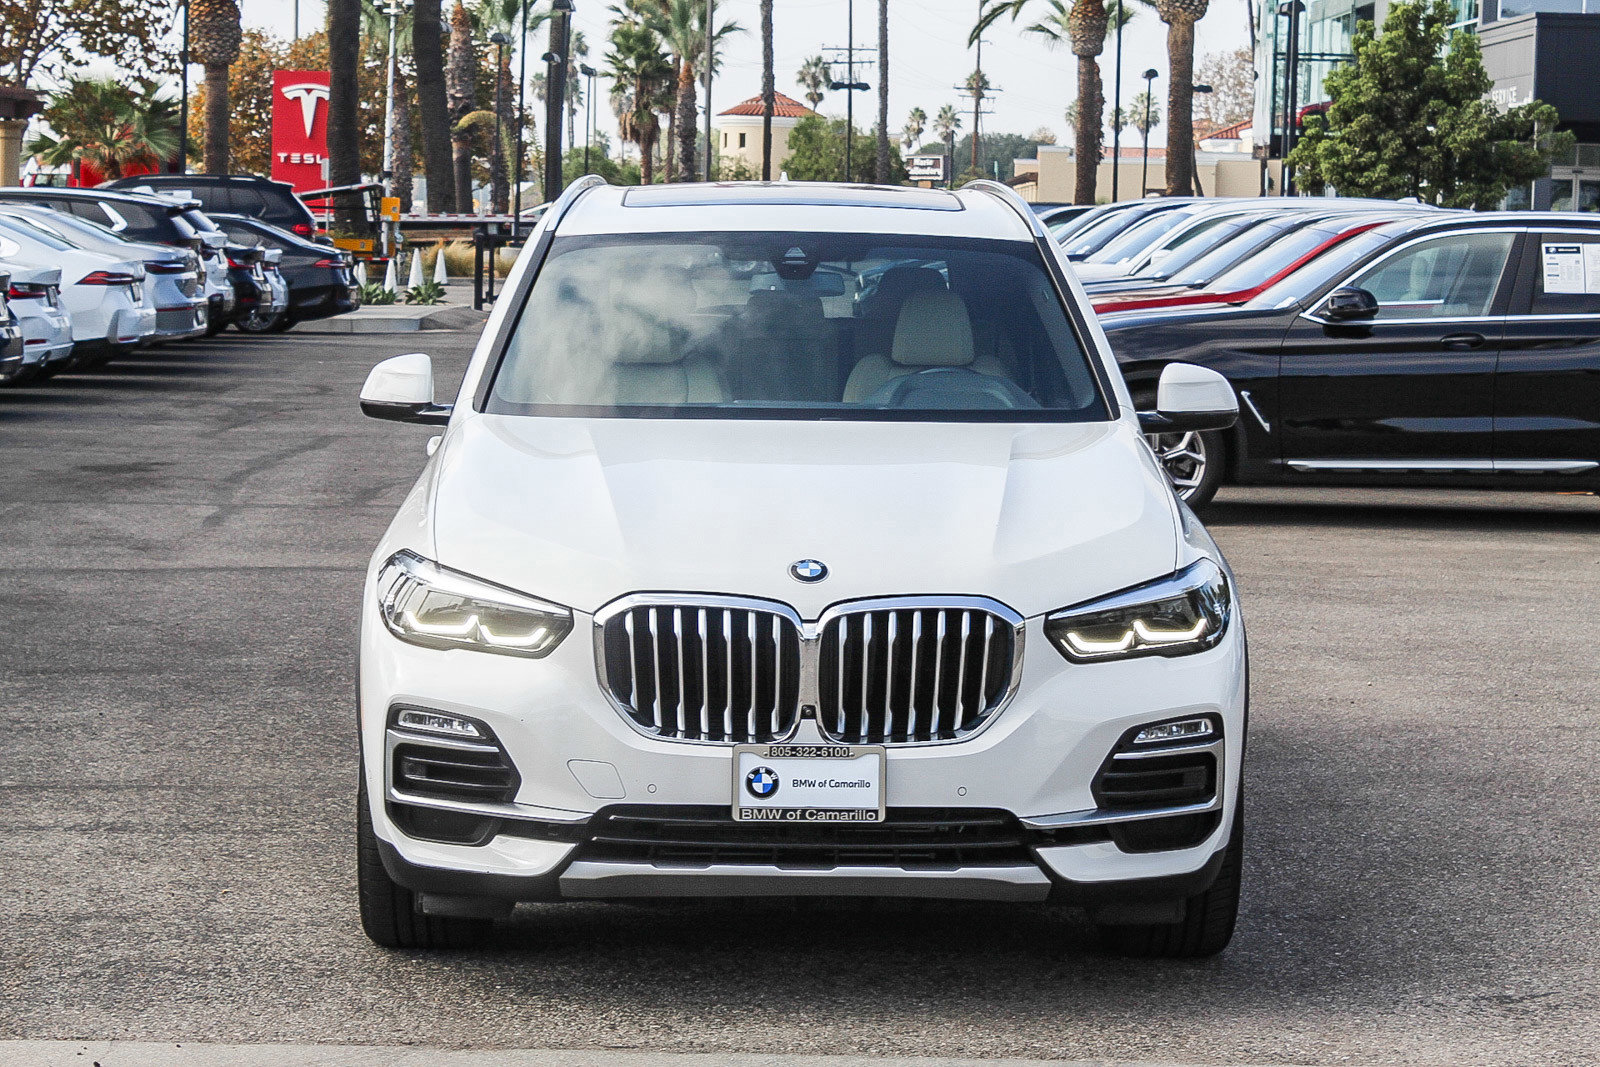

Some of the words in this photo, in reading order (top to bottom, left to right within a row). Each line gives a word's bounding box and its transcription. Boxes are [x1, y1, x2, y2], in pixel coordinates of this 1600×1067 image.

[277, 152, 323, 164] TESL
[771, 747, 849, 757] 805-322-6100
[792, 779, 816, 788] BMW
[818, 779, 828, 788] of
[829, 779, 871, 788] Camarillo
[741, 808, 782, 820] BMW
[786, 808, 802, 820] of
[805, 808, 876, 820] Camarillo
